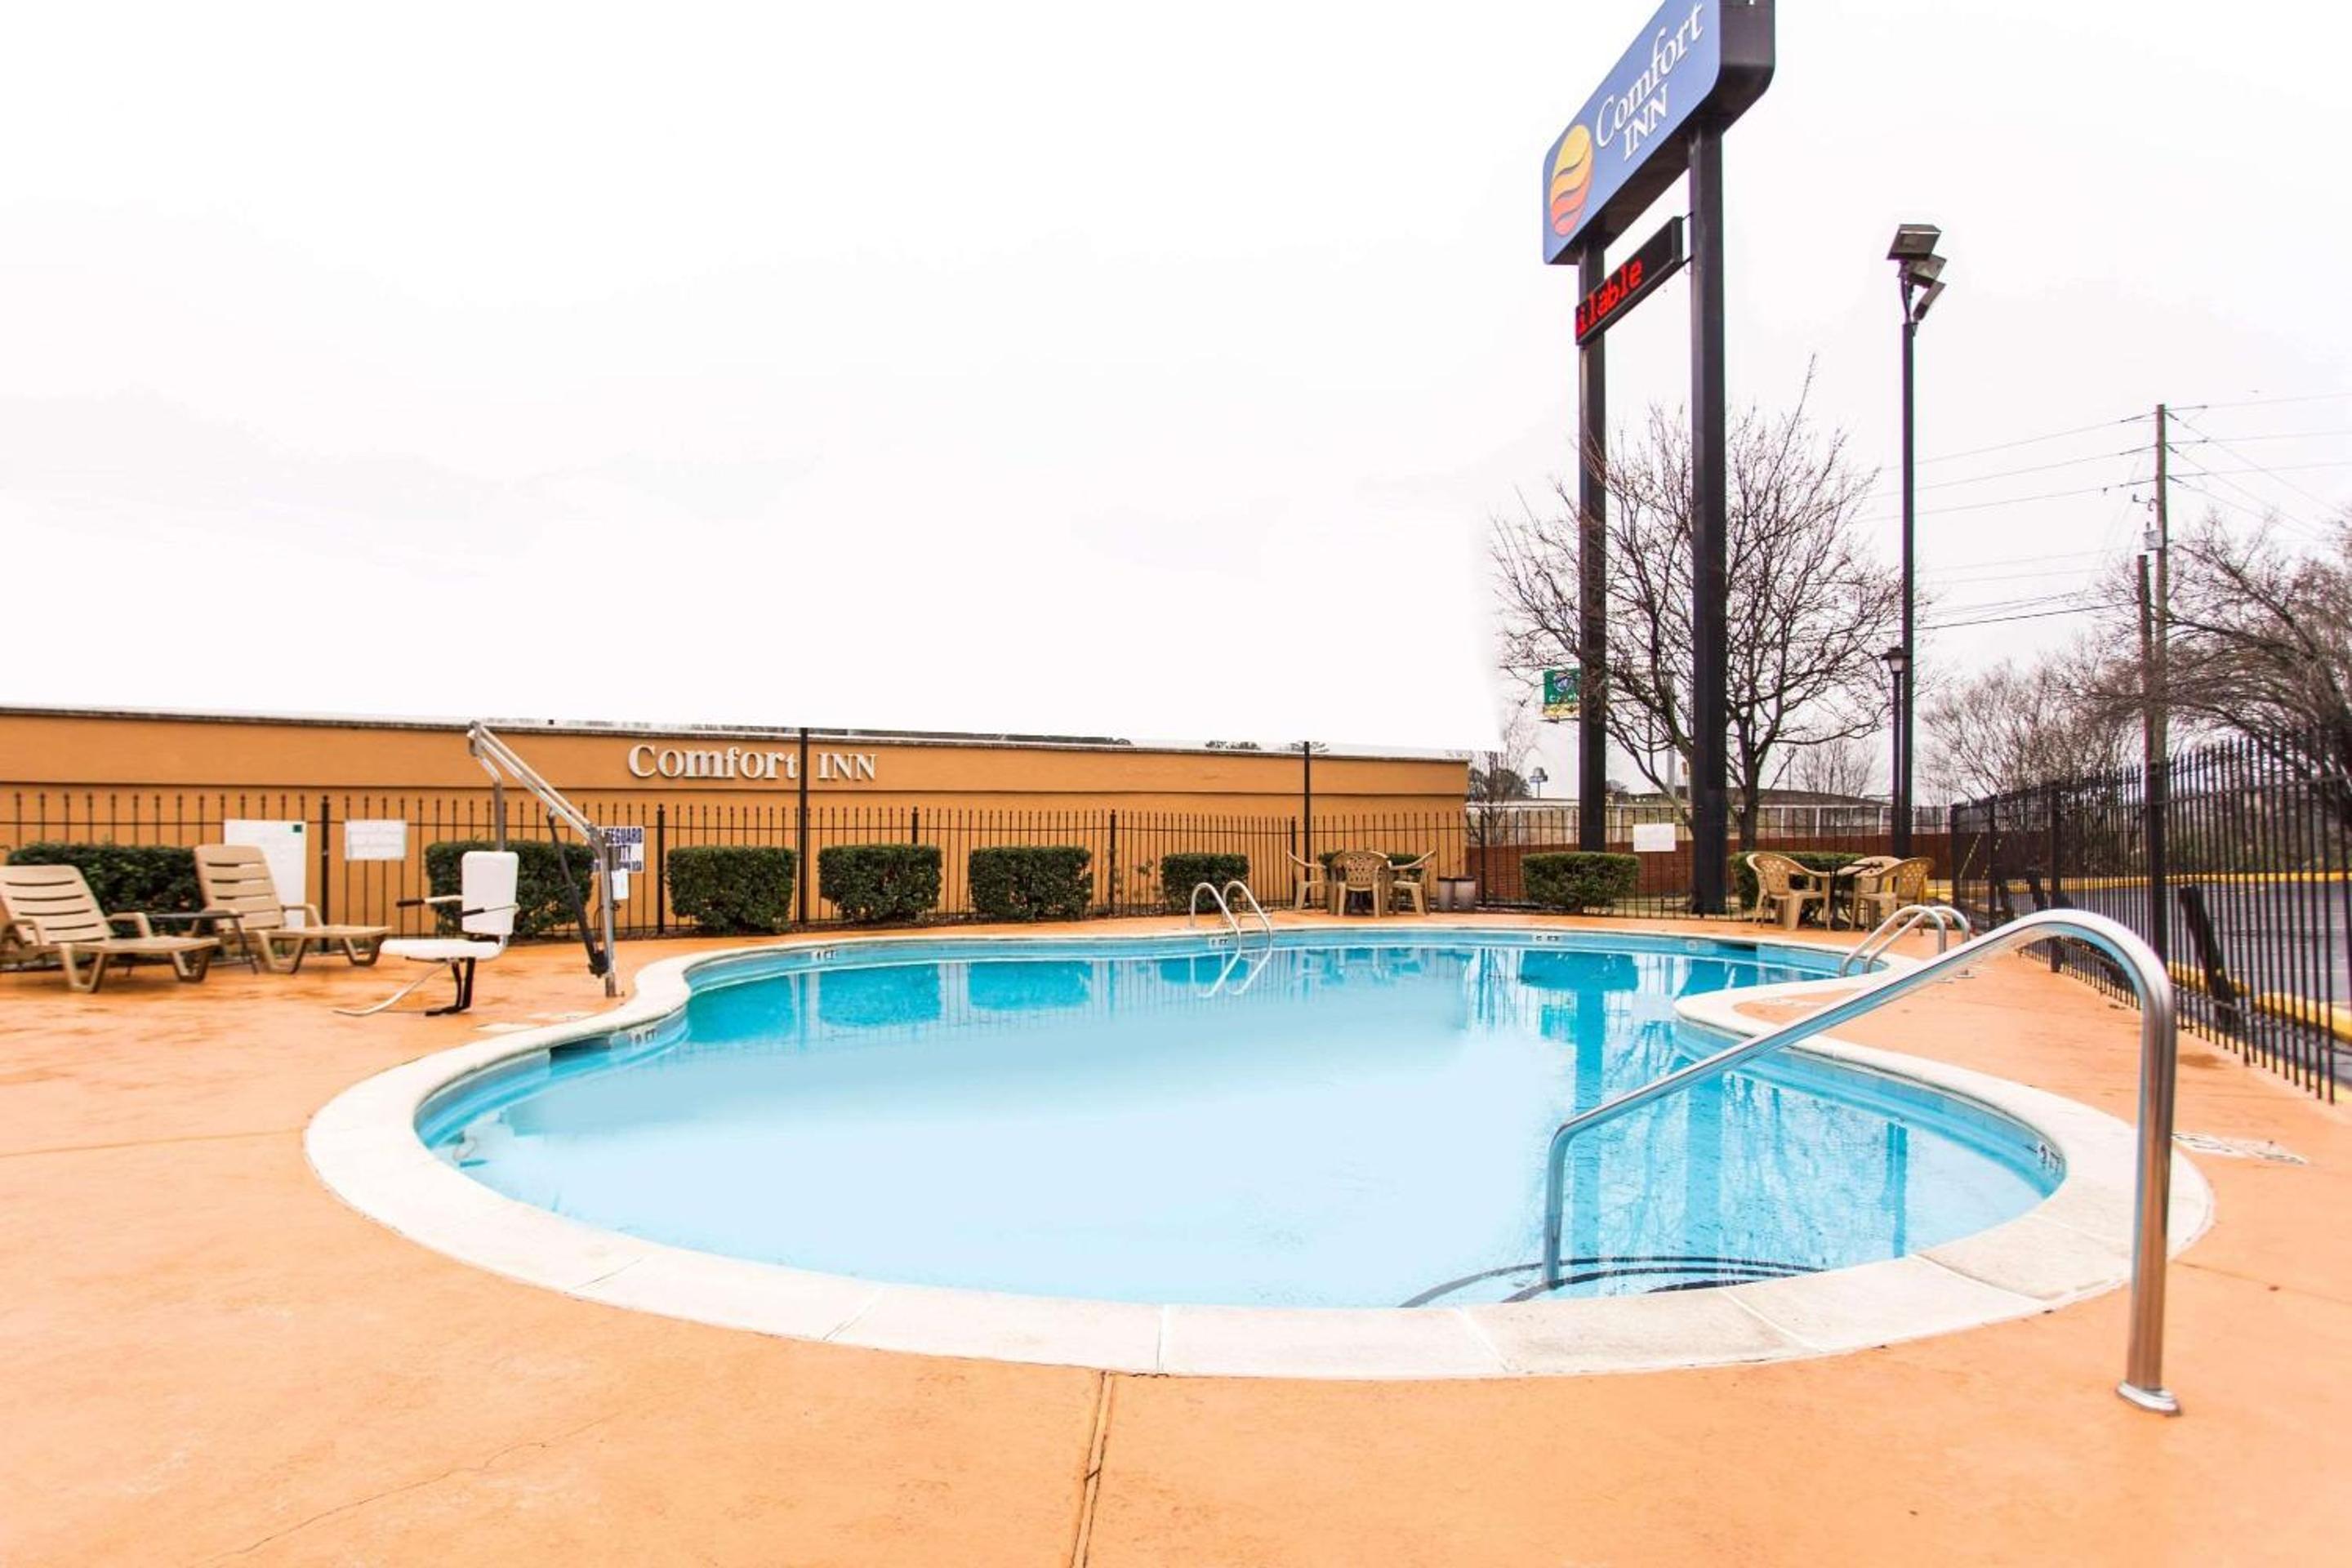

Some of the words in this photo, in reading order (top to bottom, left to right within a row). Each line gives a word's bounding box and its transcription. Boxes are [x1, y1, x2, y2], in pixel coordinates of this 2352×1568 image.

[1595, 2, 1704, 148] Comfort
[1623, 83, 1669, 163] INN
[627, 744, 800, 779] Comfort
[817, 752, 877, 781] INN
